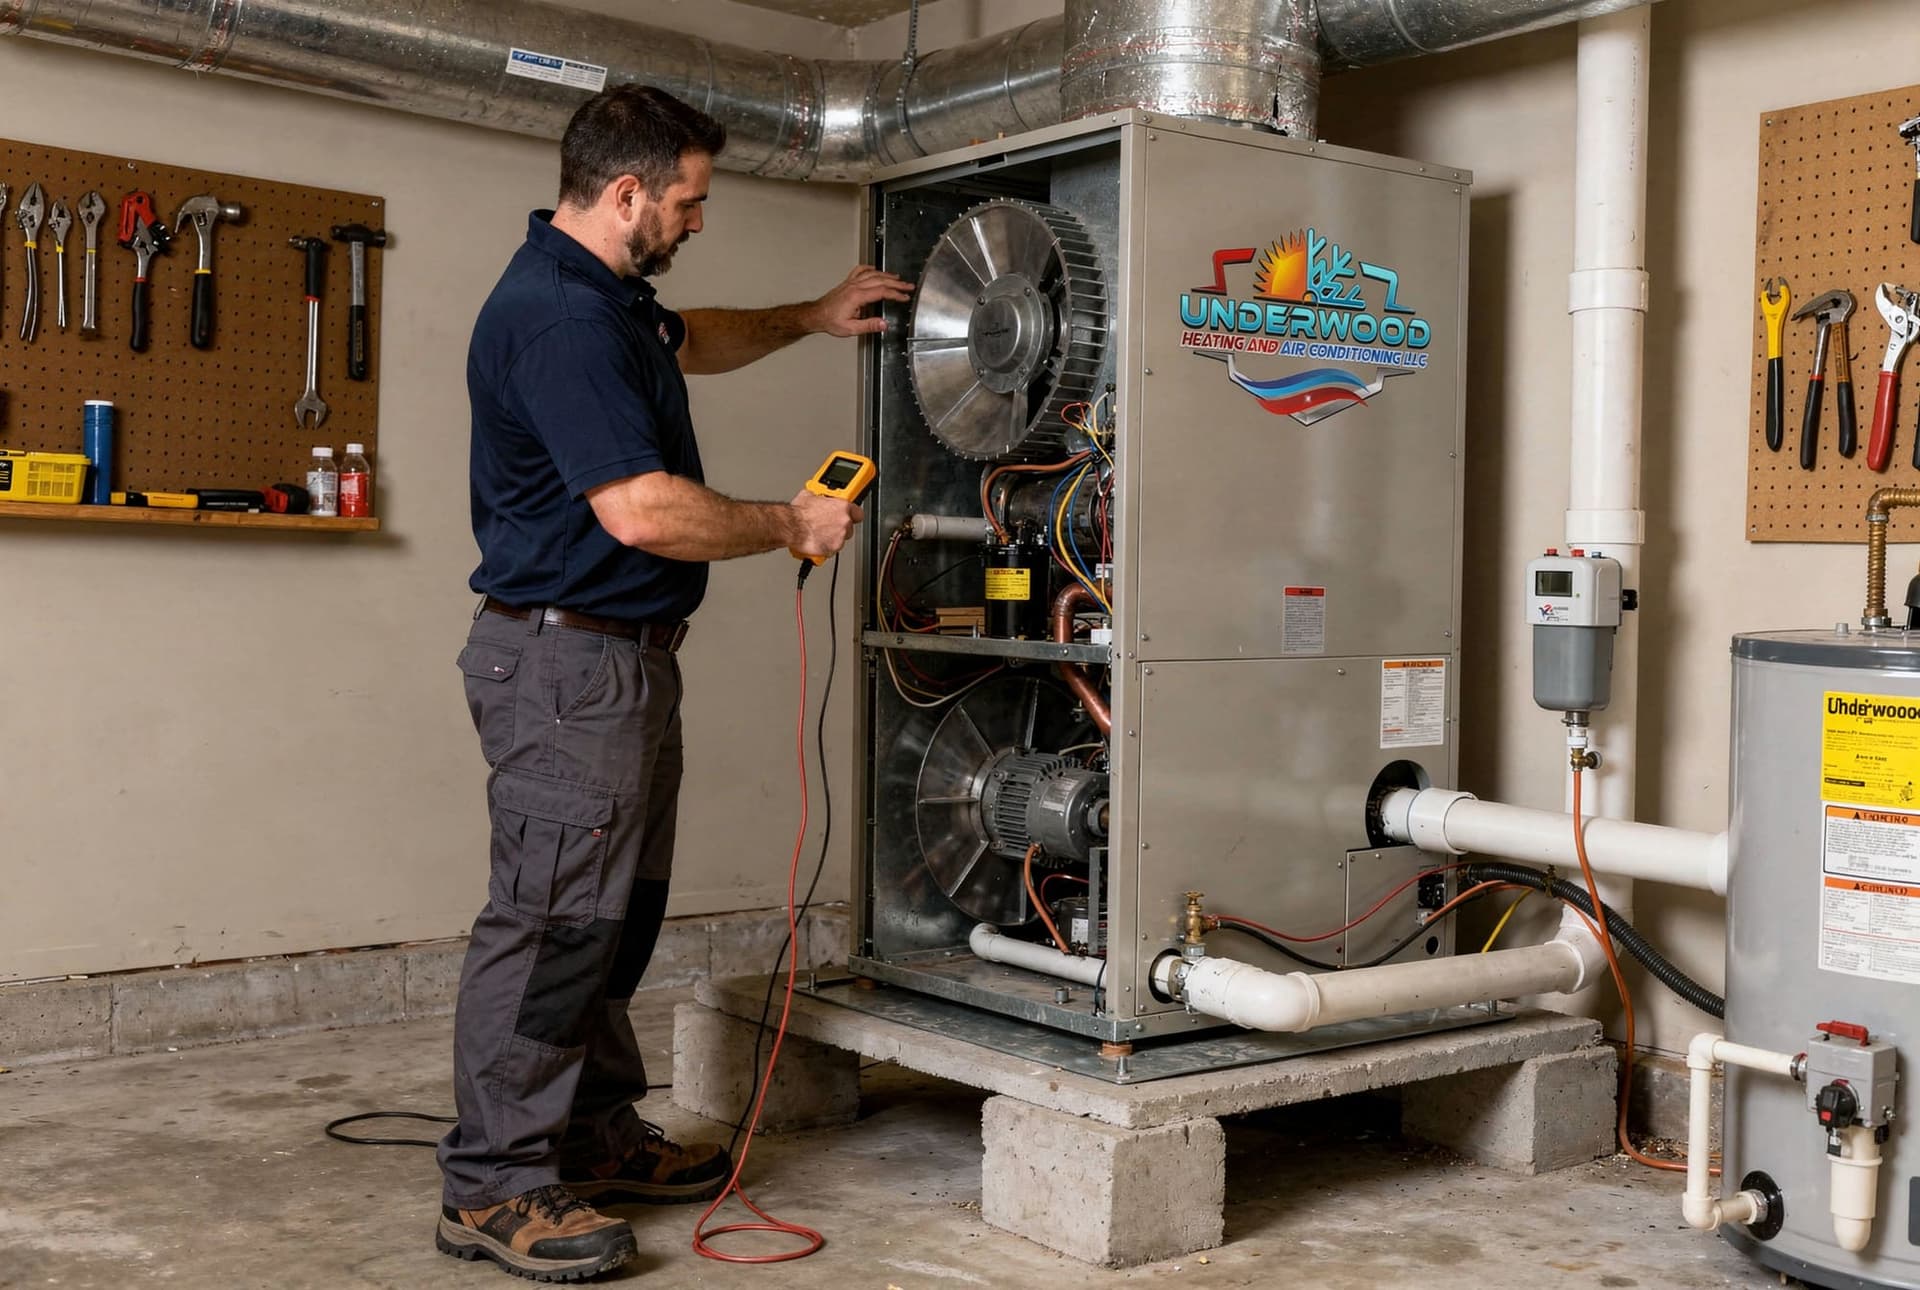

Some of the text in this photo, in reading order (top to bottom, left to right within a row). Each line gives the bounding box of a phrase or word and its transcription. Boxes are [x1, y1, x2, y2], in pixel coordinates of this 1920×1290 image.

[1180, 294, 1431, 348] UNDERWOOD
[1182, 332, 1428, 367] HEATING AND AIR CONDITIONING LLC
